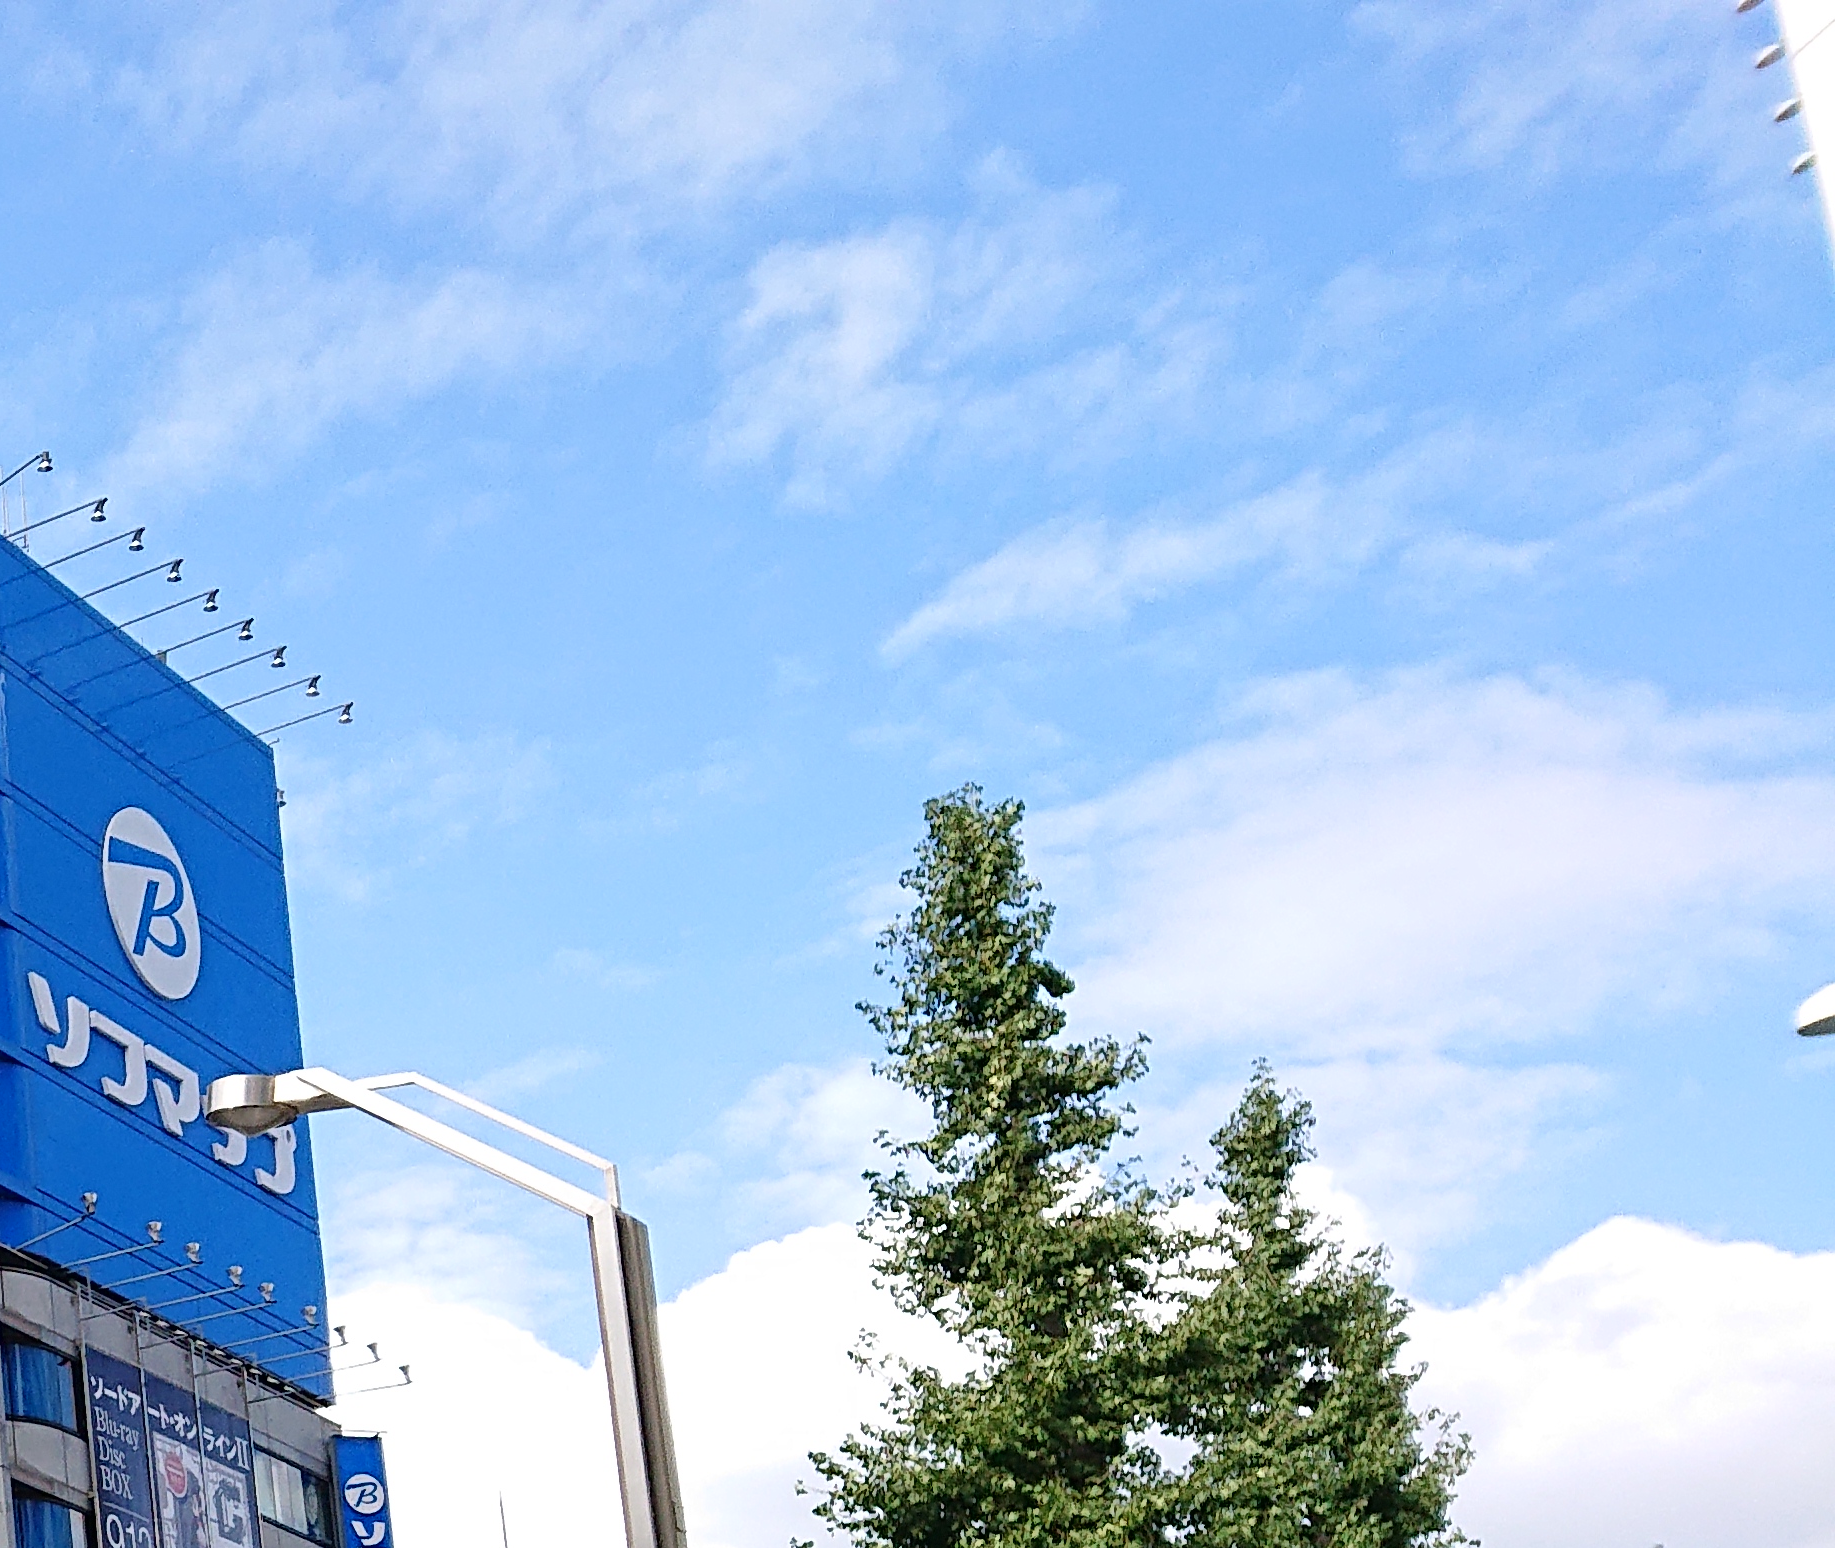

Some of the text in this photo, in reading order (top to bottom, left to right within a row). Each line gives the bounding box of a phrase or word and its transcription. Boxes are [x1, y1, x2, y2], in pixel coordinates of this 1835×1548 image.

[94, 1406, 140, 1451] Blu-ray
[98, 1436, 127, 1470] Disc
[100, 1464, 133, 1500] BOX
